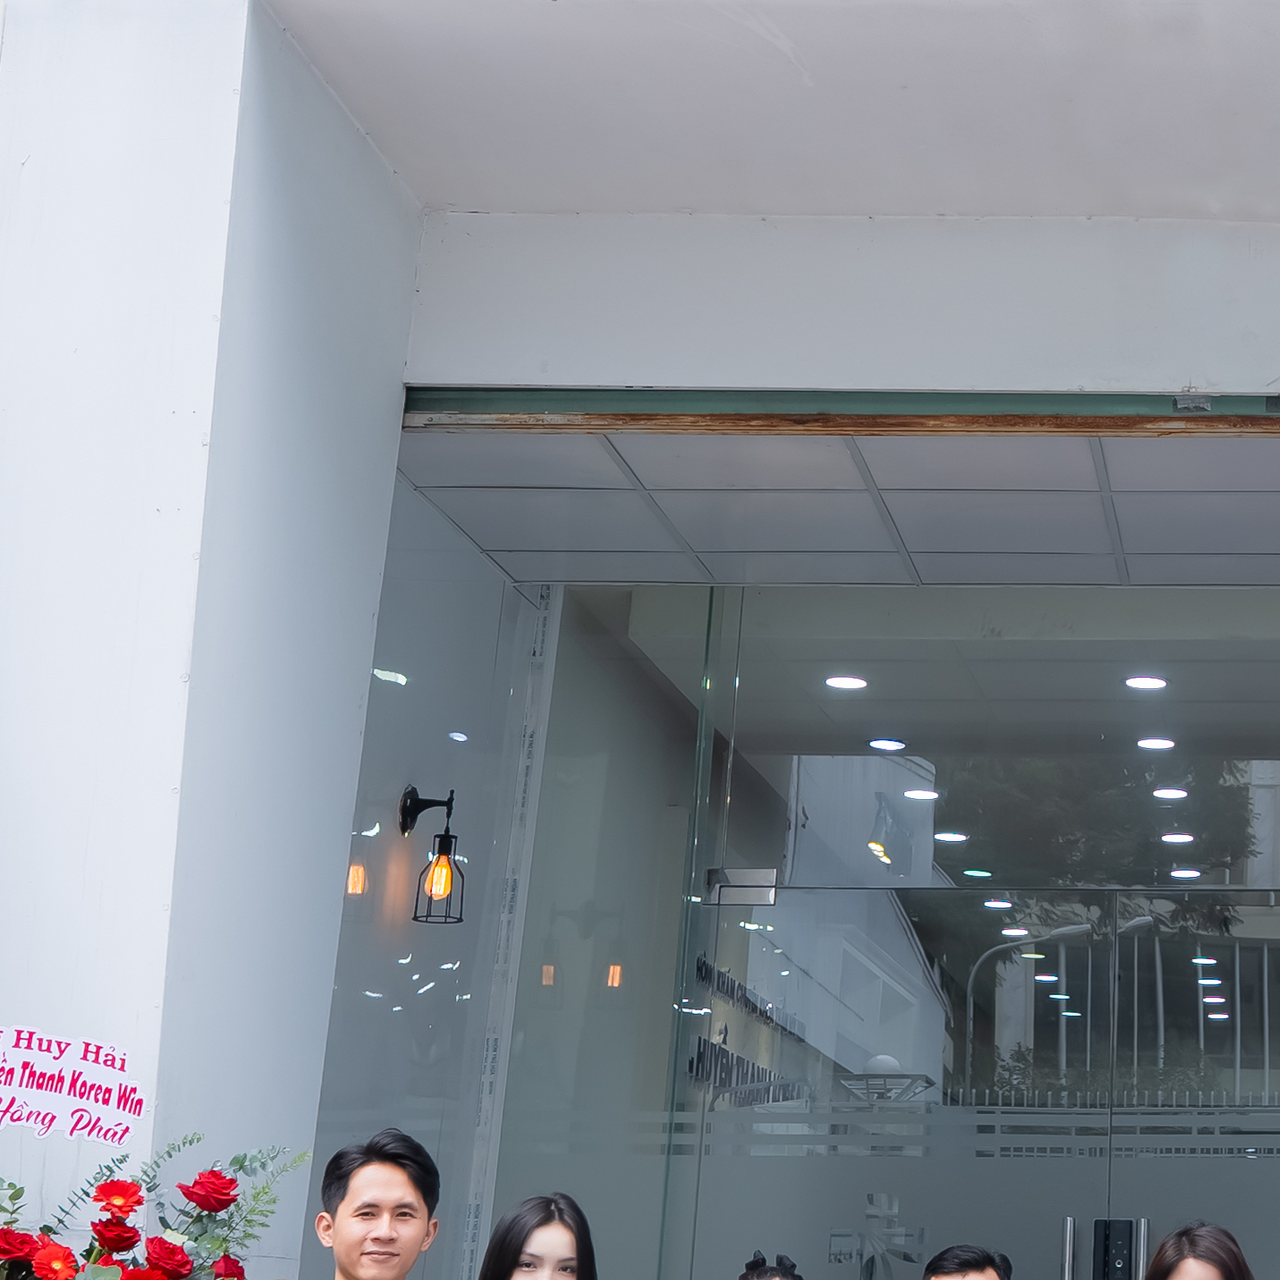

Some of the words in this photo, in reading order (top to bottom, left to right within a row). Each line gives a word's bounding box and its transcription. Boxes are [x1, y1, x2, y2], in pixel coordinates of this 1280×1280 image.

[12, 1029, 71, 1061] Huy
[80, 1041, 128, 1073] Hải
[18, 1060, 65, 1094] Thanh
[66, 1069, 114, 1107] Korea
[116, 1082, 145, 1118] Win
[0, 1095, 57, 1136] Hồng
[69, 1107, 131, 1146] Phát
